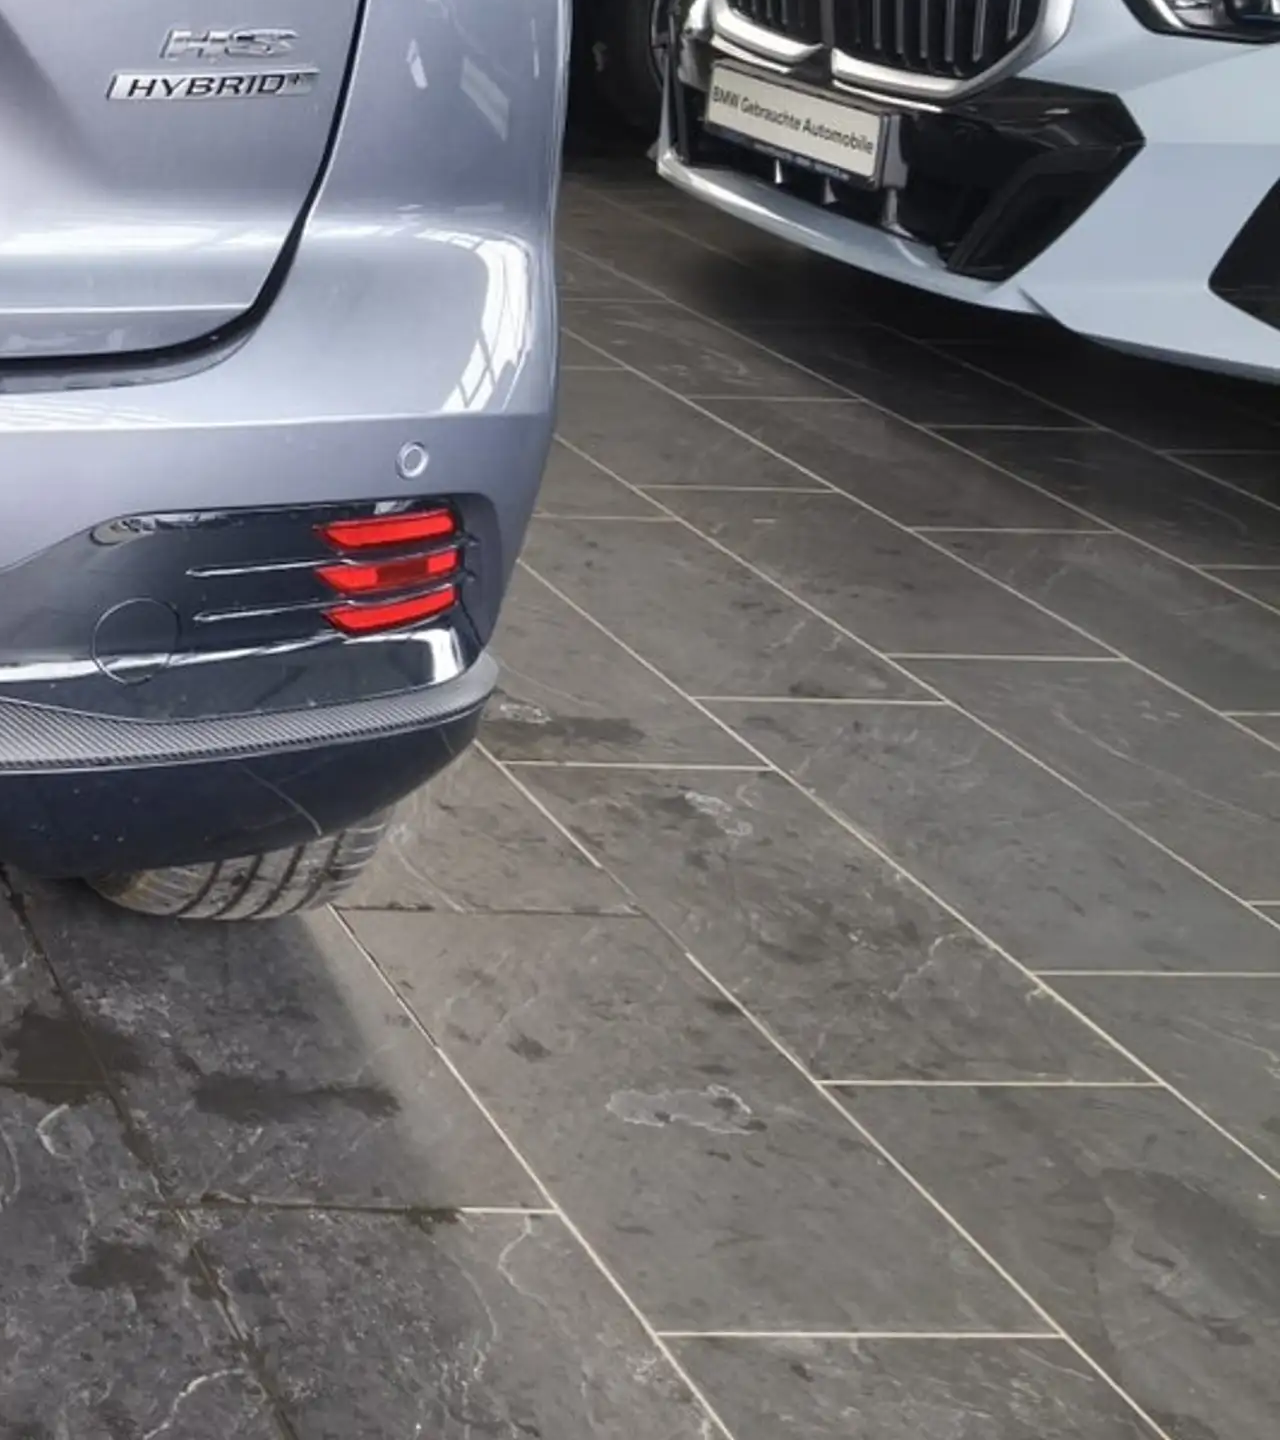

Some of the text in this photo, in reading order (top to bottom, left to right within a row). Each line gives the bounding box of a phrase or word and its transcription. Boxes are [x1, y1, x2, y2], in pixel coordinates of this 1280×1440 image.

[158, 28, 298, 60] HS
[711, 86, 874, 156] BMW Gebrauchte Automobile
